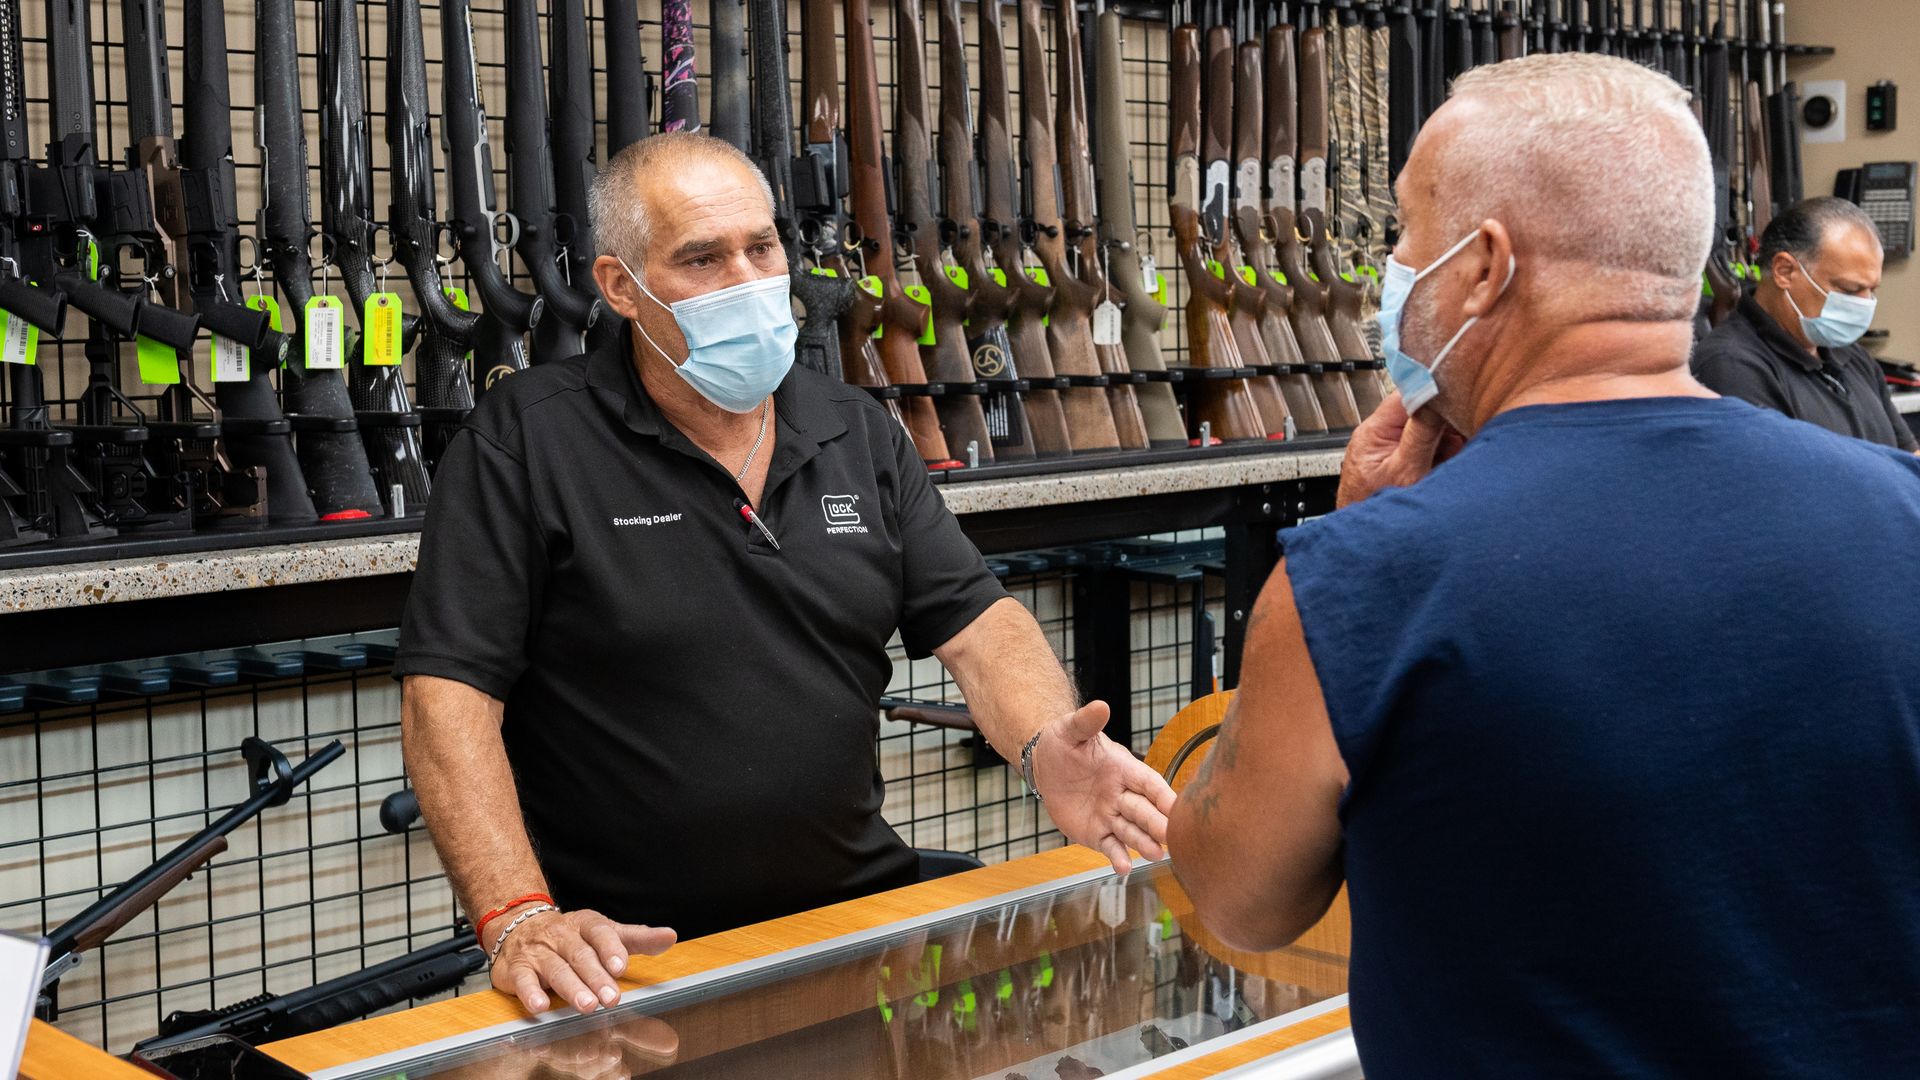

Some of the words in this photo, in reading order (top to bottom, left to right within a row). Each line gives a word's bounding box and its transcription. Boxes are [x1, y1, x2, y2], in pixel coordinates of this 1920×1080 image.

[613, 516, 652, 526] Stocking
[653, 513, 682, 523] Dealer
[826, 526, 869, 534] PERFECTION
